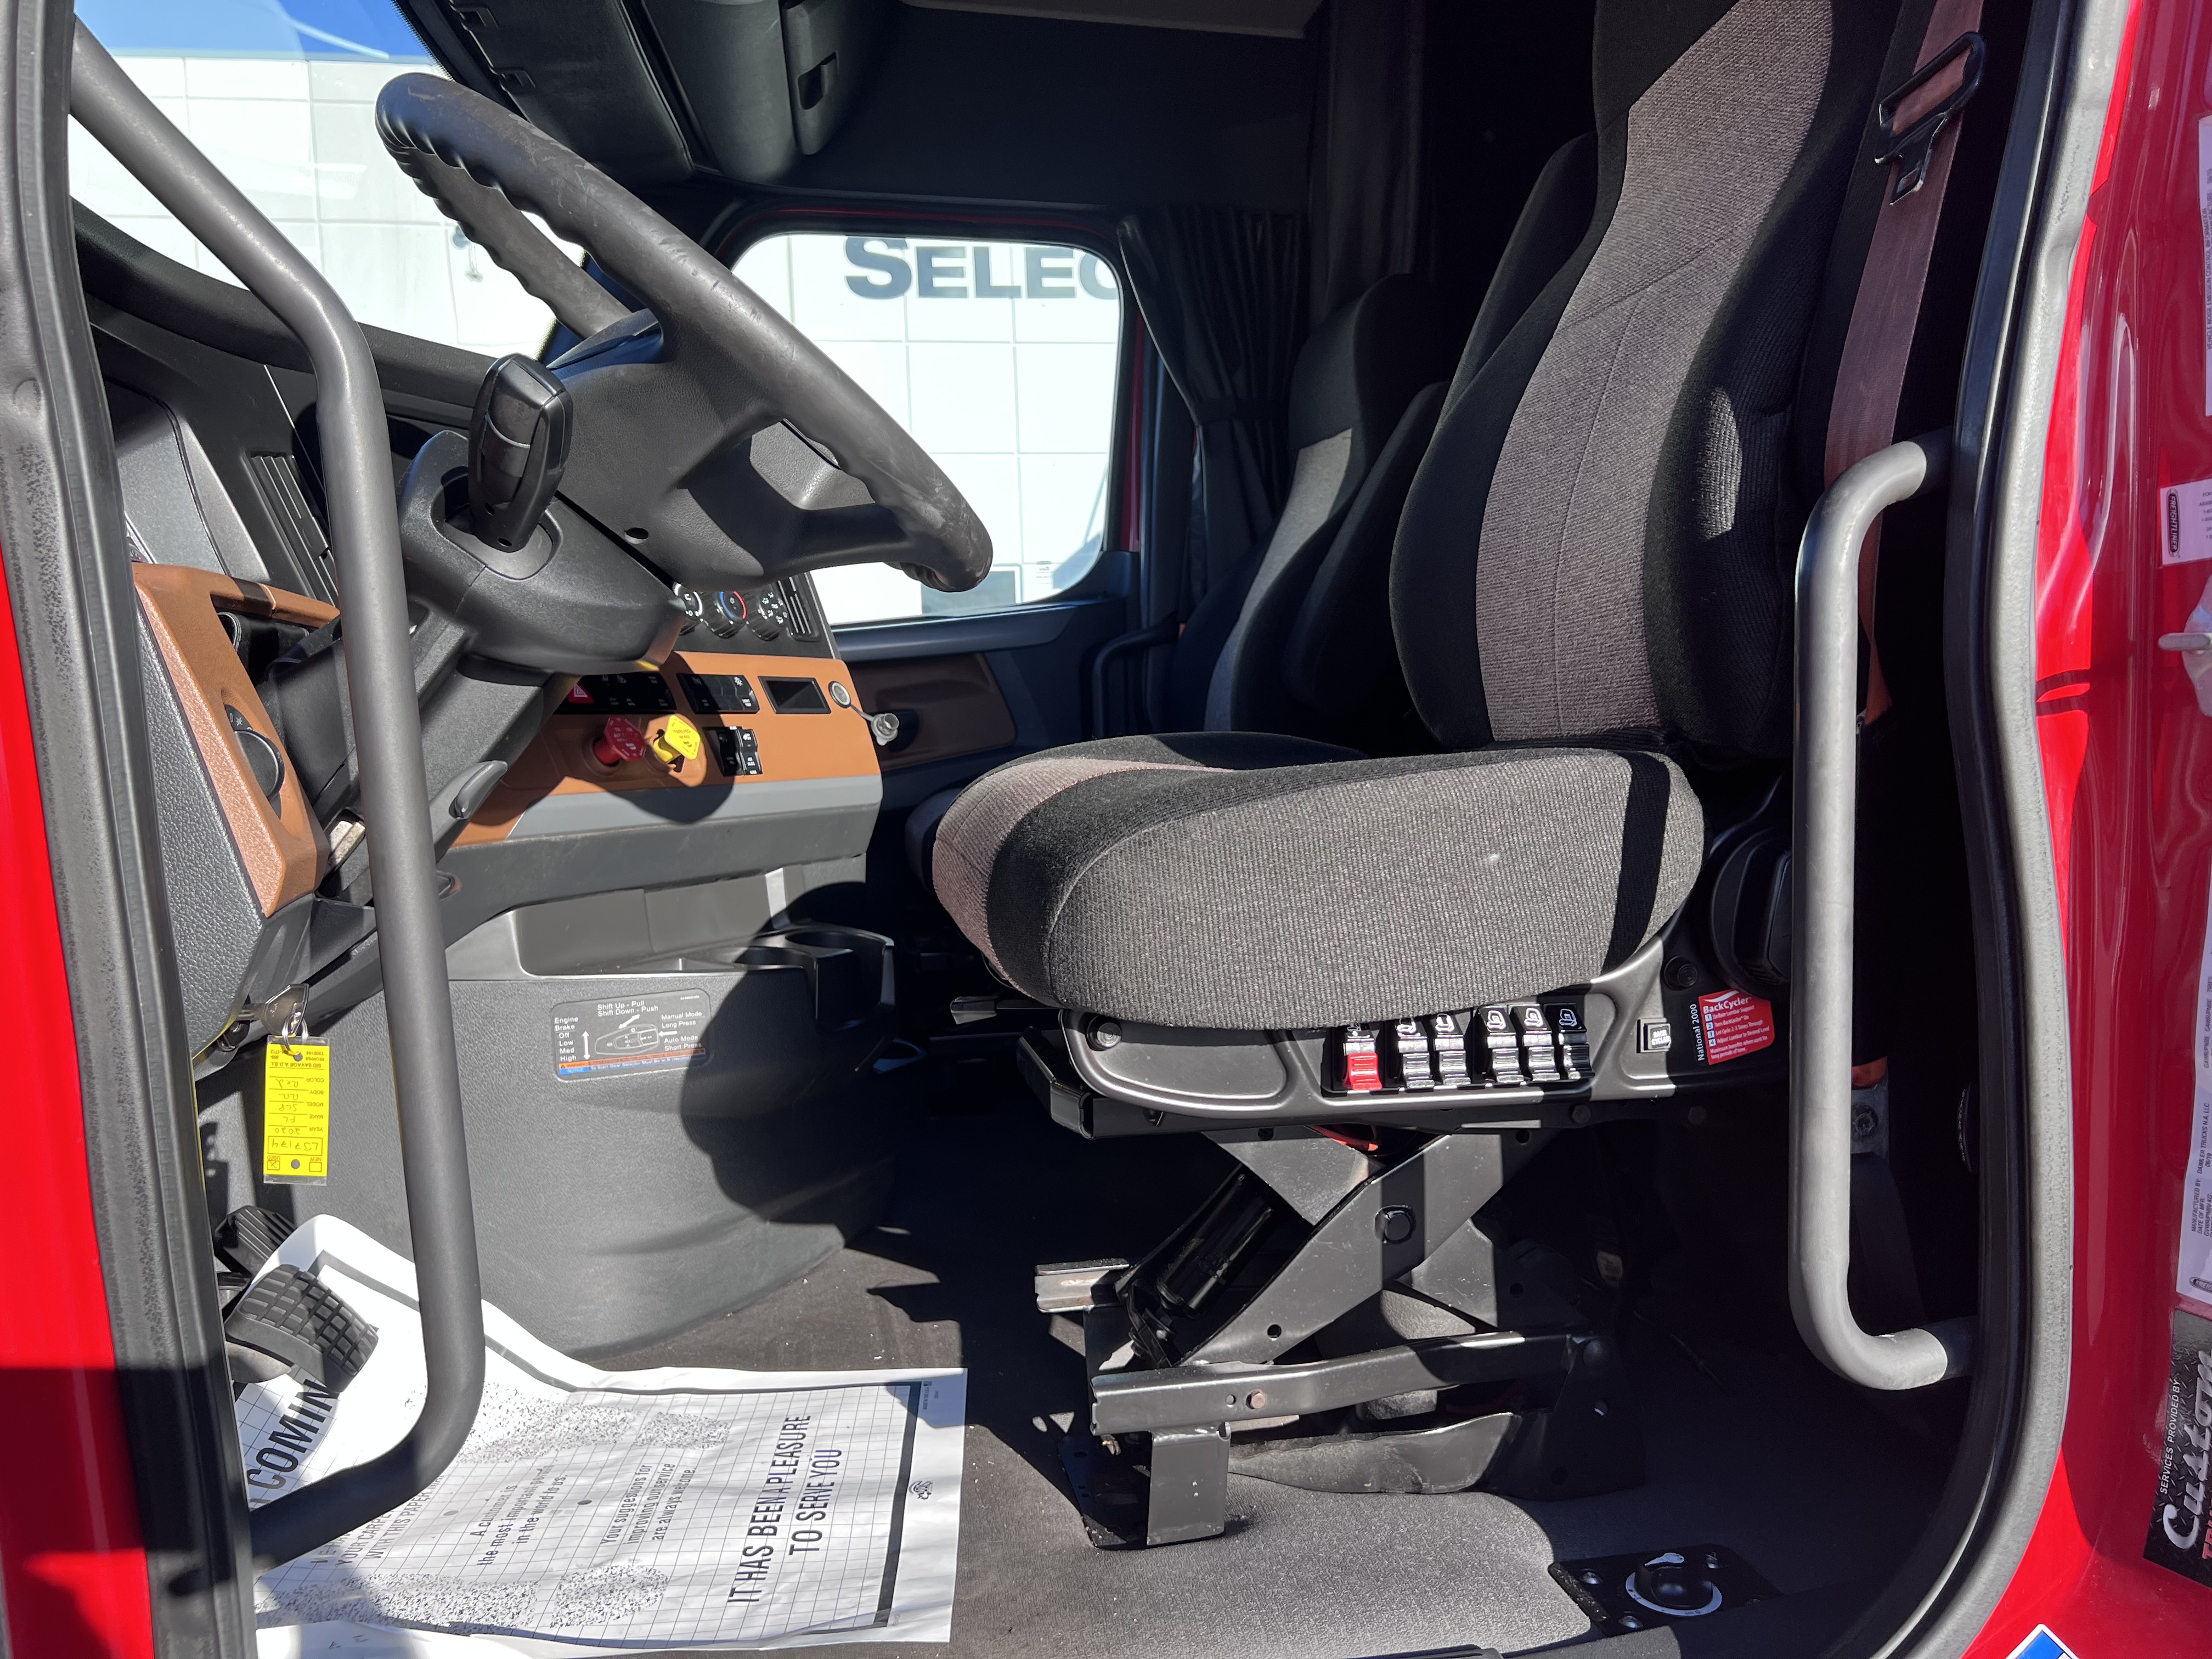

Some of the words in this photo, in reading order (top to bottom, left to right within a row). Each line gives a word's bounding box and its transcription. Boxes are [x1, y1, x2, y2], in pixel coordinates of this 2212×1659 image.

[2169, 495, 2178, 551] FREIGHTLINER
[1690, 1003, 1700, 1025] 2000
[1703, 997, 1750, 1014] BackCycler
[554, 1017, 579, 1025] Engine
[1692, 1025, 1705, 1062] National
[274, 1127, 301, 1135] 2020
[2199, 1210, 2204, 1220] OF
[2172, 1378, 2181, 1393] BY
[2167, 1395, 2180, 1443] PROVIDED
[765, 1415, 811, 1485] PLEASURE
[809, 1449, 842, 1479] YOU
[2160, 1446, 2174, 1494] SERVICES
[478, 1494, 510, 1527] customer
[500, 1485, 518, 1493] is
[500, 1485, 538, 1521] important
[531, 1496, 554, 1515] world
[600, 1525, 623, 1544] Your
[635, 1465, 653, 1475] for
[623, 1502, 659, 1545] improving
[653, 1463, 675, 1488] service
[657, 1496, 682, 1524] always
[795, 1482, 835, 1521] SERVE
[364, 1537, 397, 1559] WITH
[385, 1519, 411, 1536] THIS
[399, 1492, 431, 1516] PAPER
[518, 1517, 539, 1532] the
[747, 1496, 787, 1537] BEEN
[335, 1541, 369, 1565] YOUR
[358, 1509, 394, 1539] CARPE
[490, 1523, 514, 1547] most
[511, 1534, 531, 1544] in
[651, 1526, 668, 1541] are
[788, 1530, 823, 1555] TO
[476, 1550, 499, 1566] the
[735, 1545, 774, 1581] HAS
[727, 1587, 763, 1602] IT
